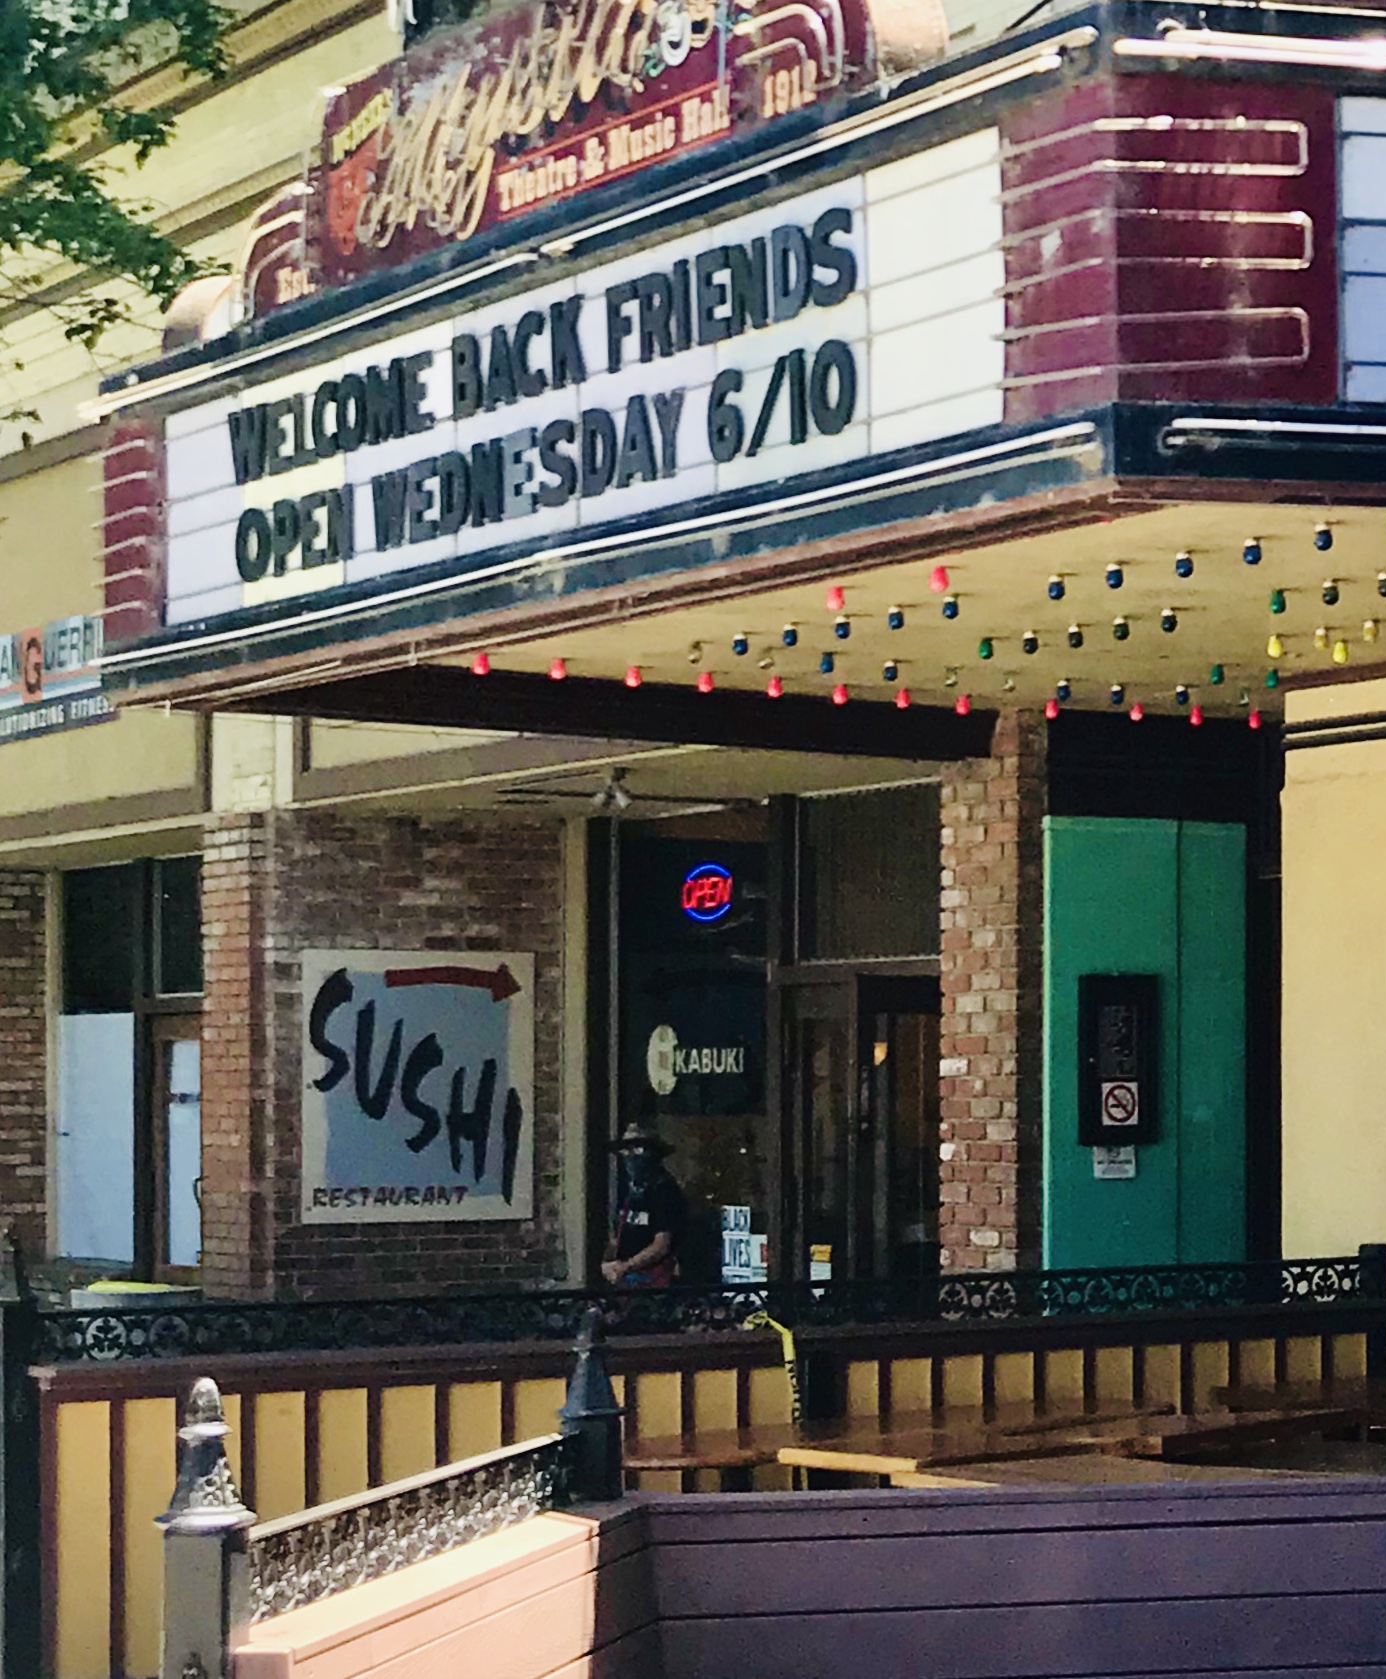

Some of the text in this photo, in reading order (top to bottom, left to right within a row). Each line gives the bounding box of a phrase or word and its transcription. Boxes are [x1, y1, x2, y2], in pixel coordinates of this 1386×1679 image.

[499, 84, 730, 211] Theatre & Music Hall
[228, 208, 857, 485] WELCOME BACK FRIENDS
[236, 339, 855, 582] OPEN WEDNESDAY 6/10
[682, 876, 733, 909] OPEN
[310, 967, 523, 1207] SUSHI
[675, 1048, 744, 1073] KABUKI
[313, 1184, 469, 1208] RESTAURANT
